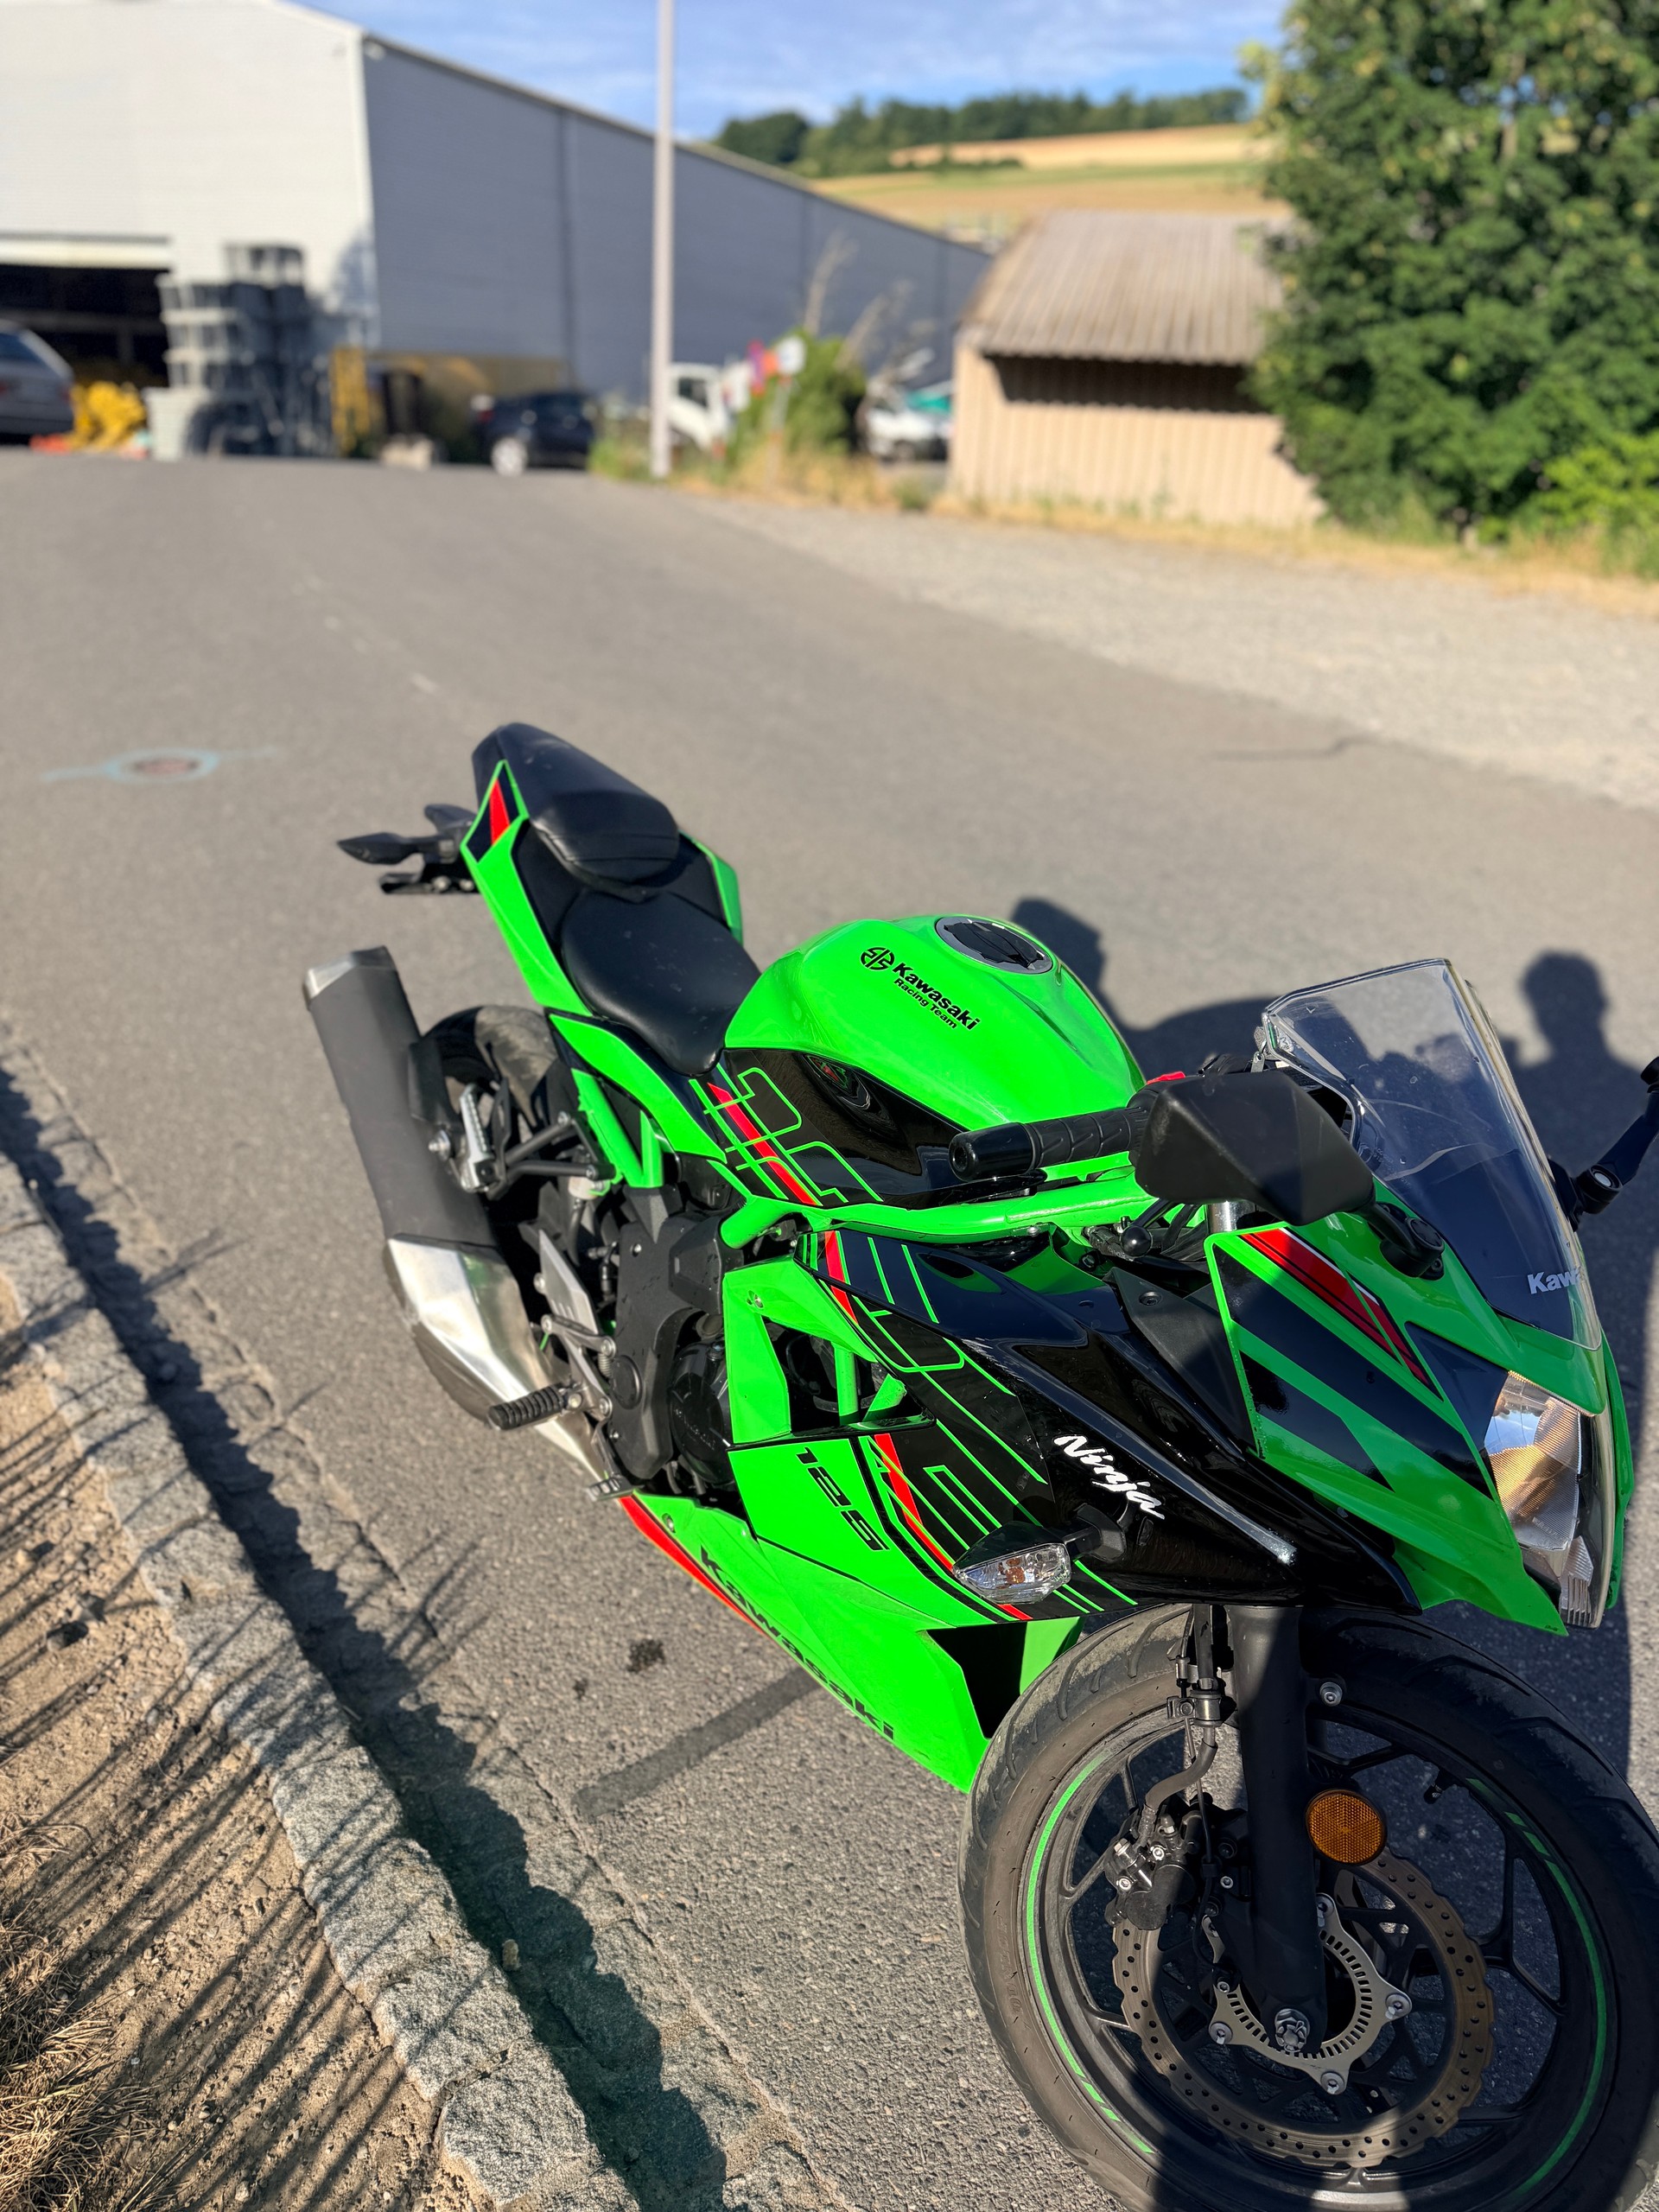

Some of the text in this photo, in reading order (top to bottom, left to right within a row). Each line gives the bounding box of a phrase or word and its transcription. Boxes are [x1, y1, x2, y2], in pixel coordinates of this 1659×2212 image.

[893, 963, 981, 1030] Kawasaki
[893, 977, 957, 1029] Racing Team
[796, 1446, 890, 1551] 125
[1053, 1435, 1165, 1520] Ninja
[700, 1545, 894, 1740] Kawasaki
